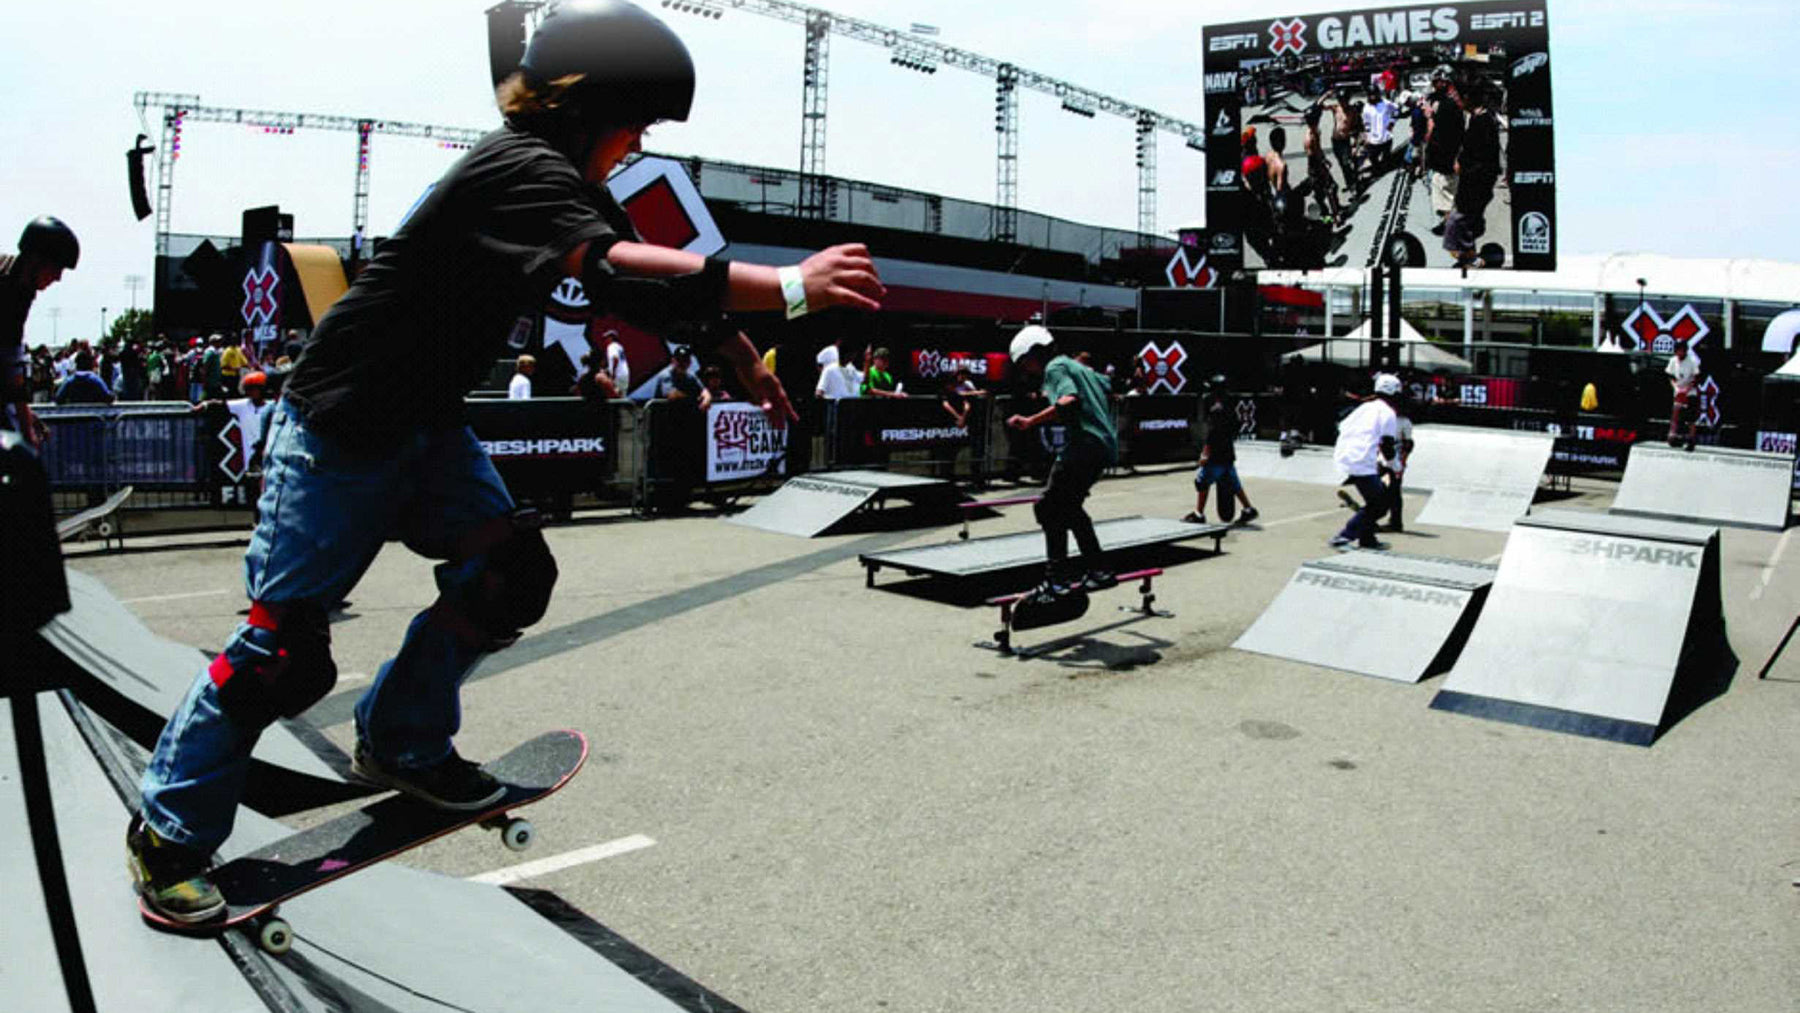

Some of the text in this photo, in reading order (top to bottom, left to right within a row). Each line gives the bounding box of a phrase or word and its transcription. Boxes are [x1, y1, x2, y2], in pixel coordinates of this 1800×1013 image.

[1317, 7, 1460, 50] GAMES
[1470, 10, 1544, 30] ESPN 2
[1209, 33, 1258, 51] ESPN
[1205, 71, 1238, 92] NAVY
[940, 358, 987, 373] GAMES
[881, 427, 968, 441] FRESHPARK
[480, 437, 604, 454] RESHPARK
[1294, 571, 1464, 607] FRESHPARK
